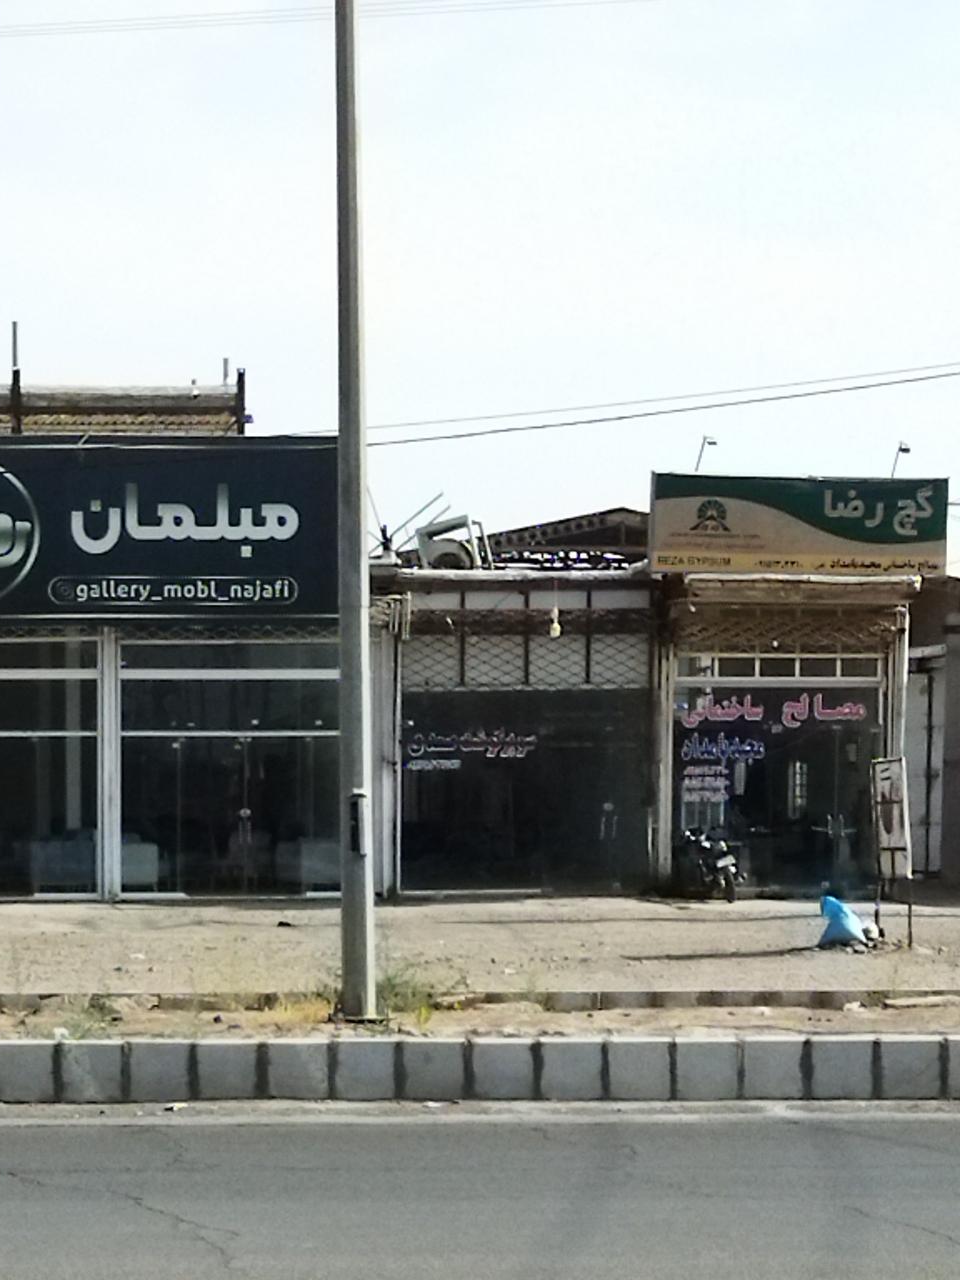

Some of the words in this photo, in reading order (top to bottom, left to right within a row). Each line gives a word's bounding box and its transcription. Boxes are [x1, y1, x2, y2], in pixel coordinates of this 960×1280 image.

[71, 483, 300, 558] مبلمان
[823, 489, 884, 528] رضا
[893, 486, 935, 536] گچ
[75, 578, 290, 602] gallery_mobl_najafi
[781, 693, 868, 728] مصالح
